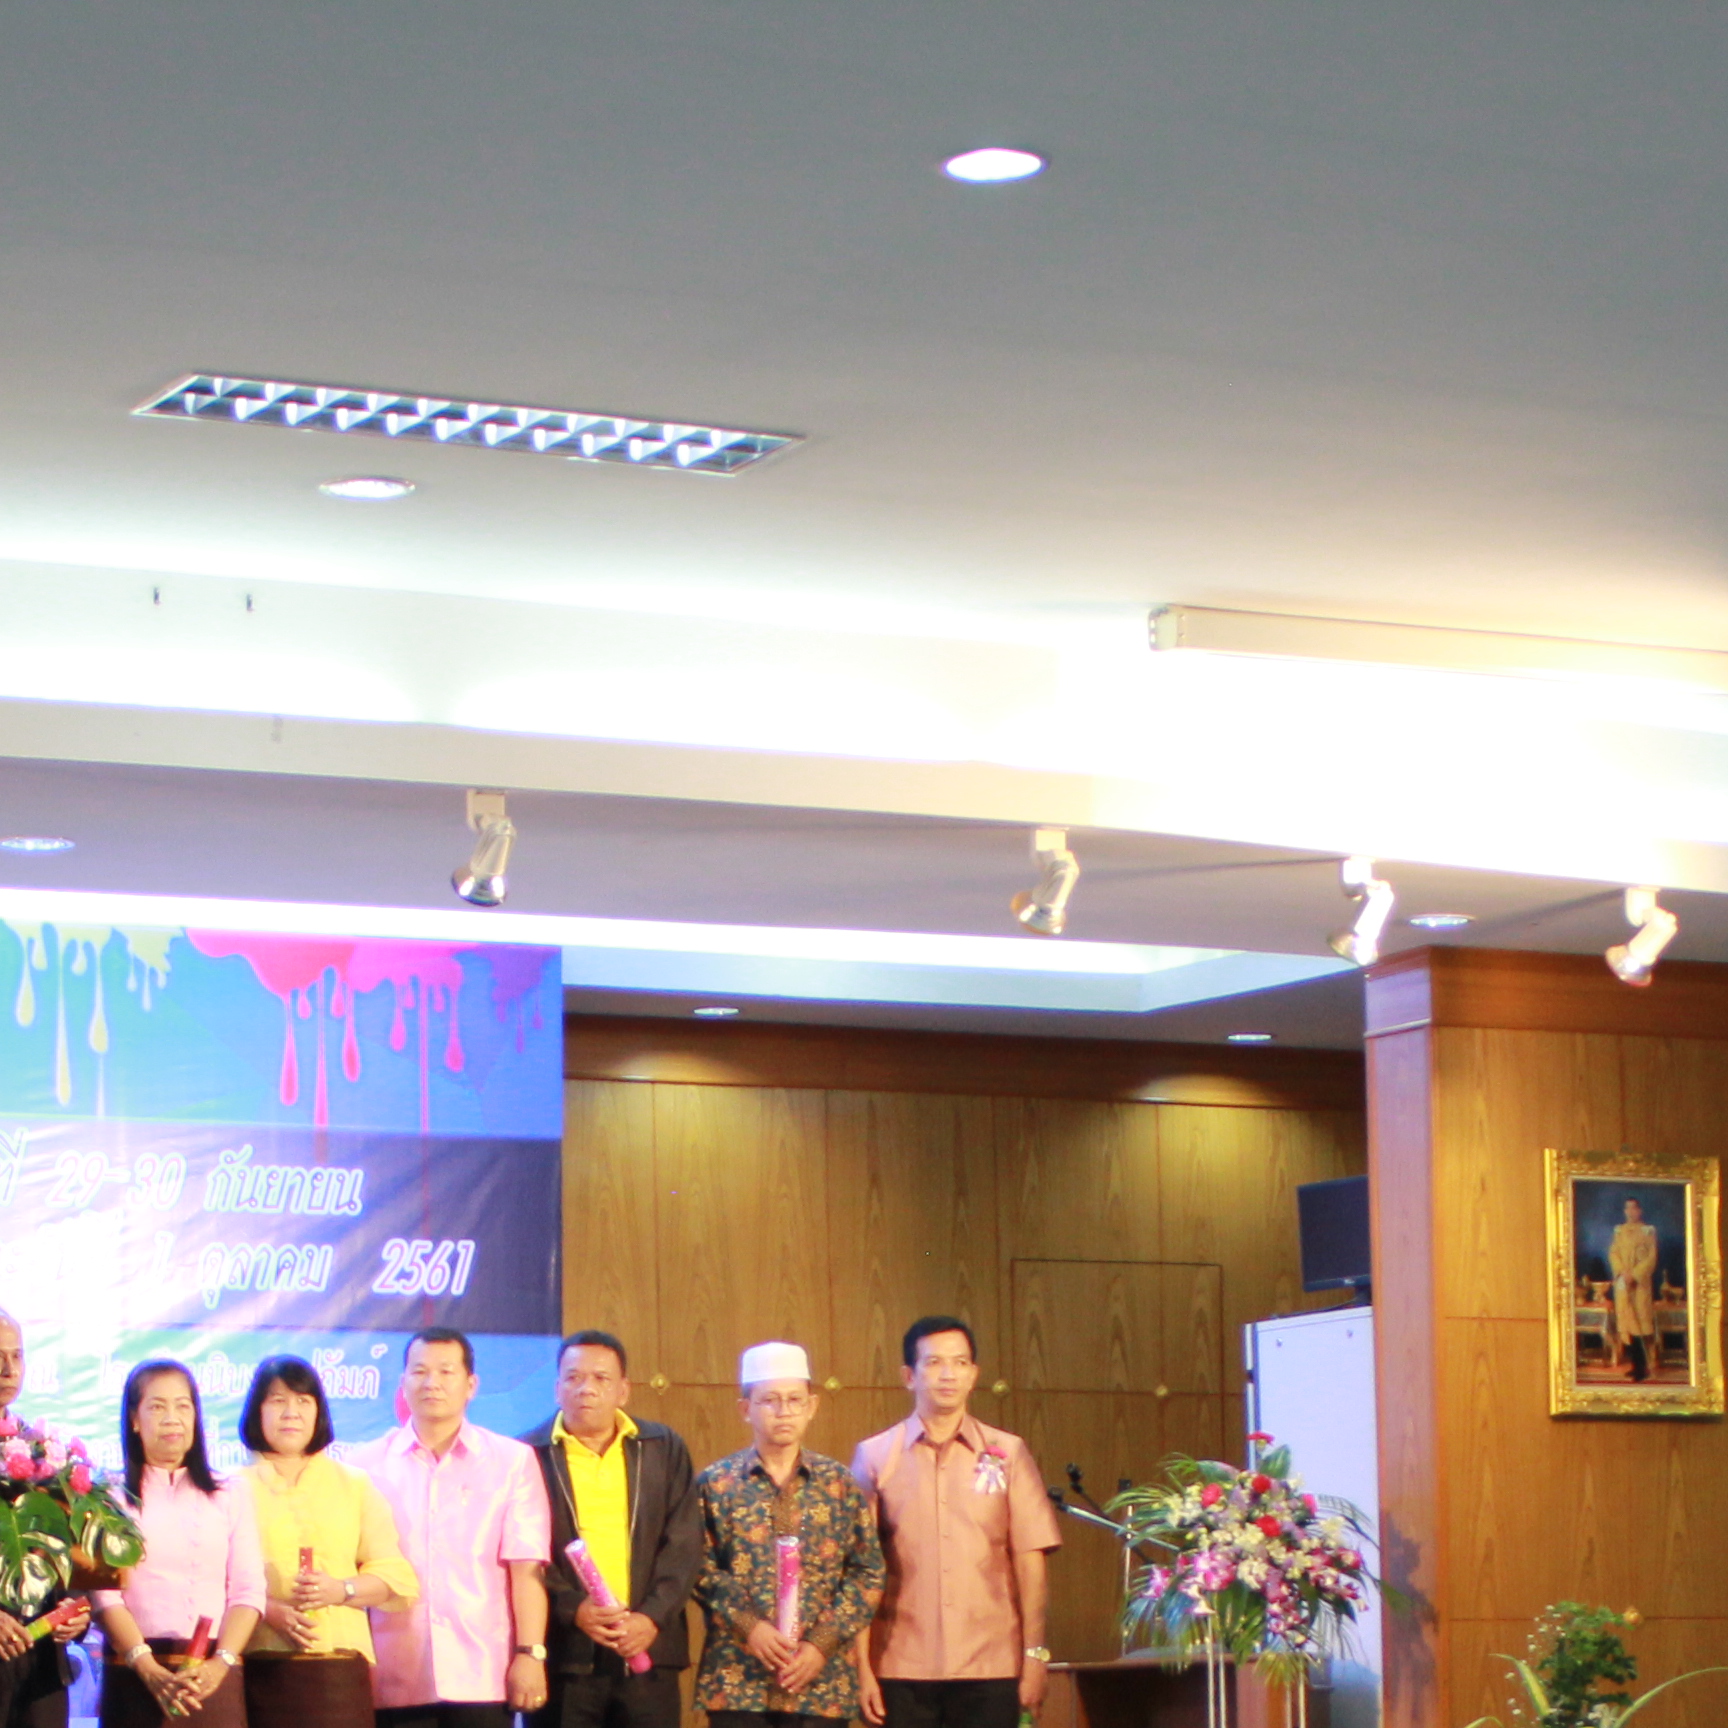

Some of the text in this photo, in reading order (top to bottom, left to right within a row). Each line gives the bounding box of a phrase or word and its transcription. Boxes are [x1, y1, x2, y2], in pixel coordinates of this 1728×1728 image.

[203, 1145, 364, 1217] กันยายน
[372, 1237, 476, 1297] 2561
